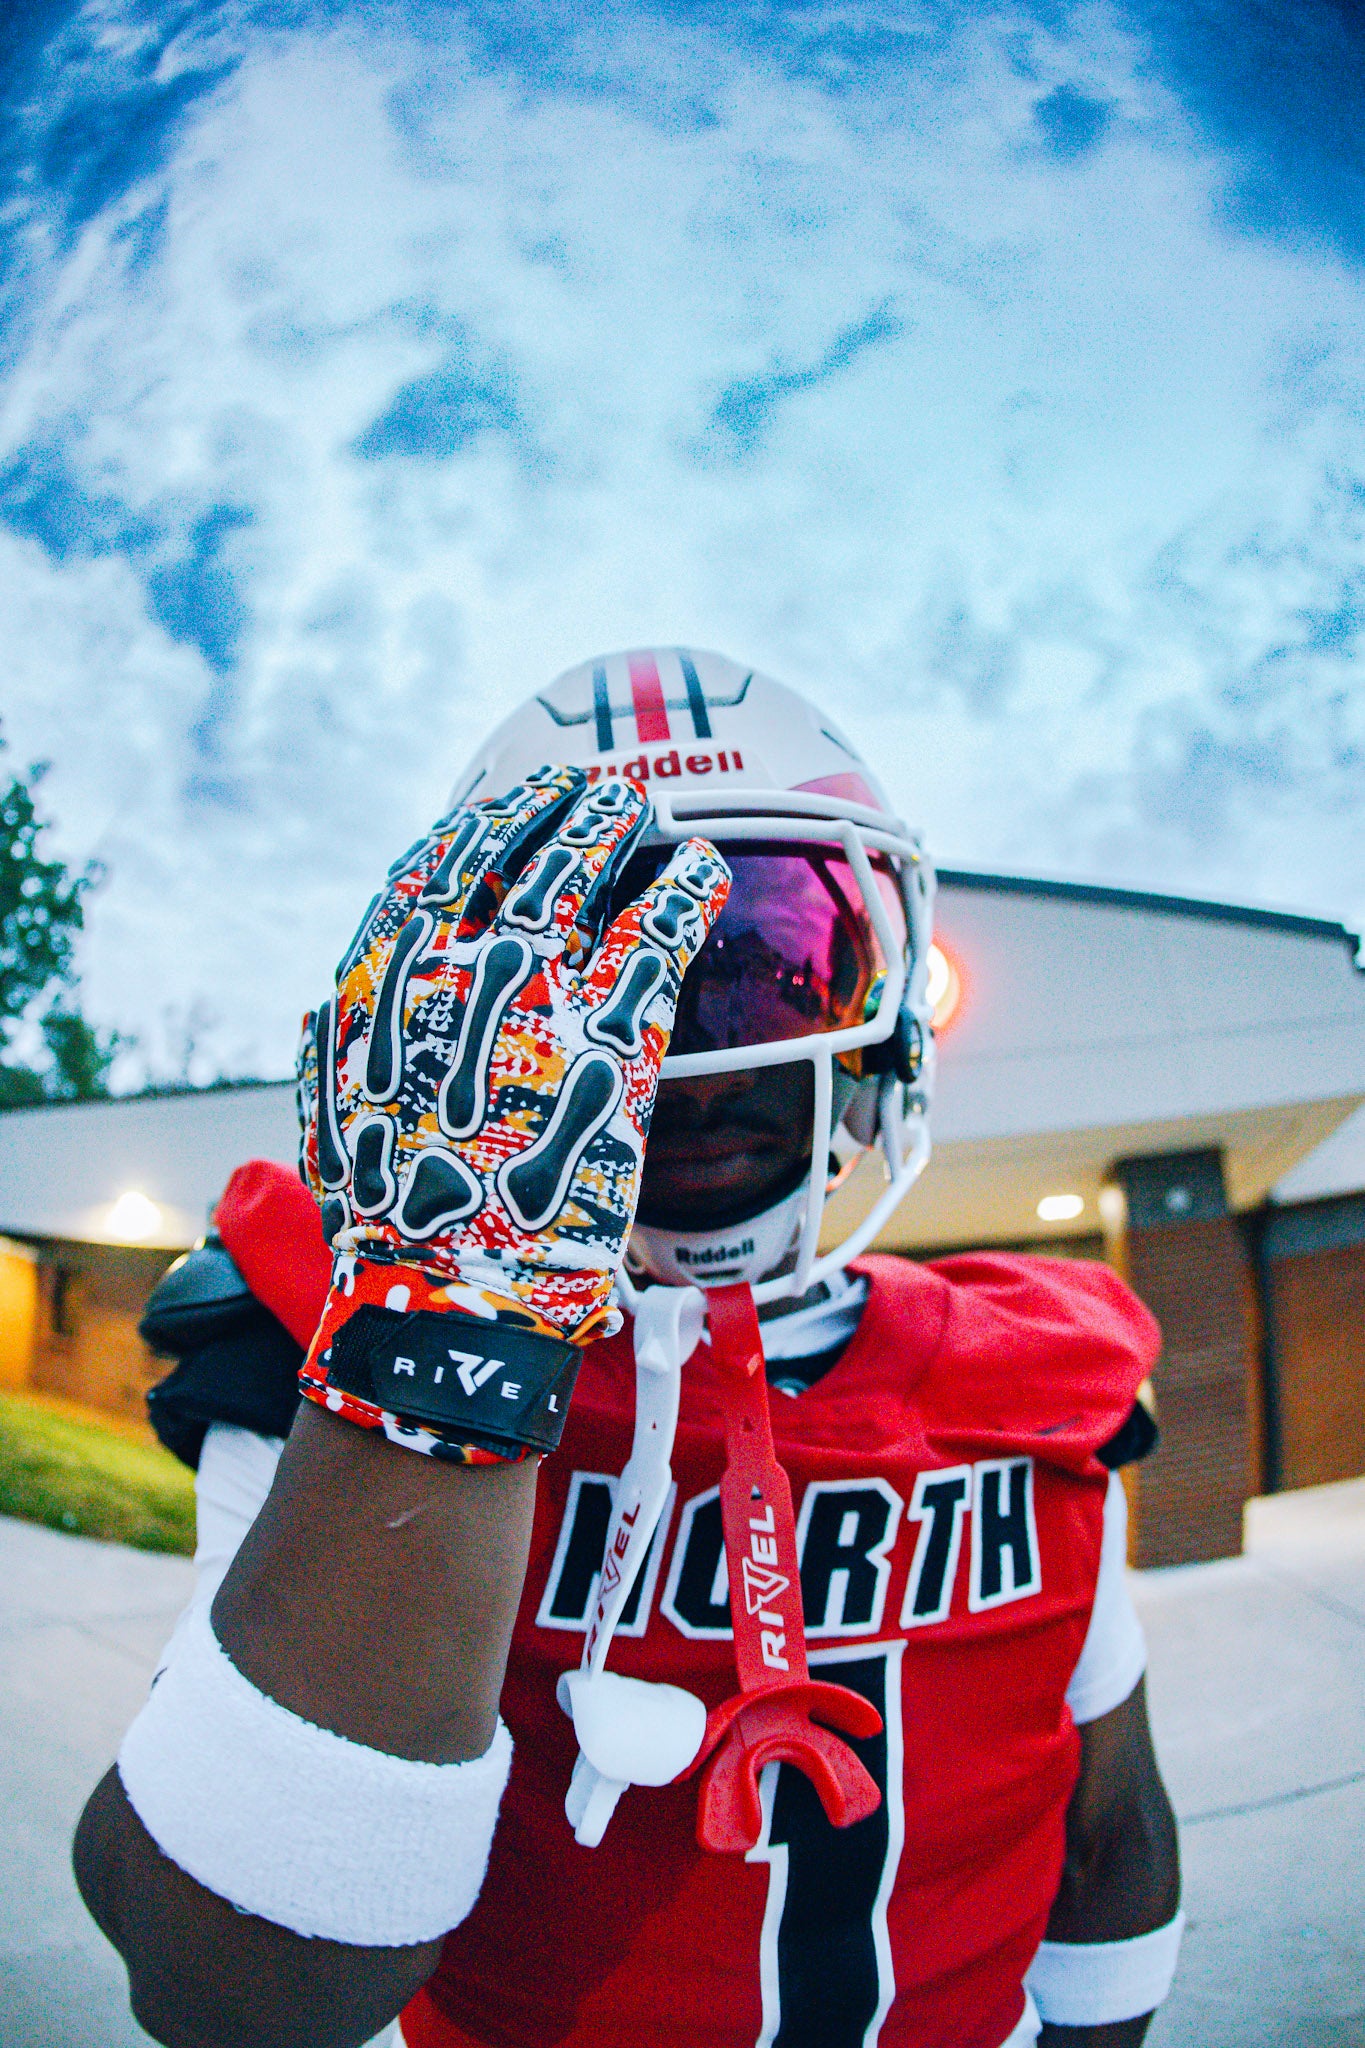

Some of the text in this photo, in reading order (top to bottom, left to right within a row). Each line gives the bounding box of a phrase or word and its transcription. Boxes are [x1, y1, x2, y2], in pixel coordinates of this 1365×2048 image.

[675, 1237, 754, 1265] Riddell
[393, 1349, 559, 1413] RIVEL
[535, 1455, 1042, 1639] NORTH
[742, 1504, 790, 1672] RIVEL
